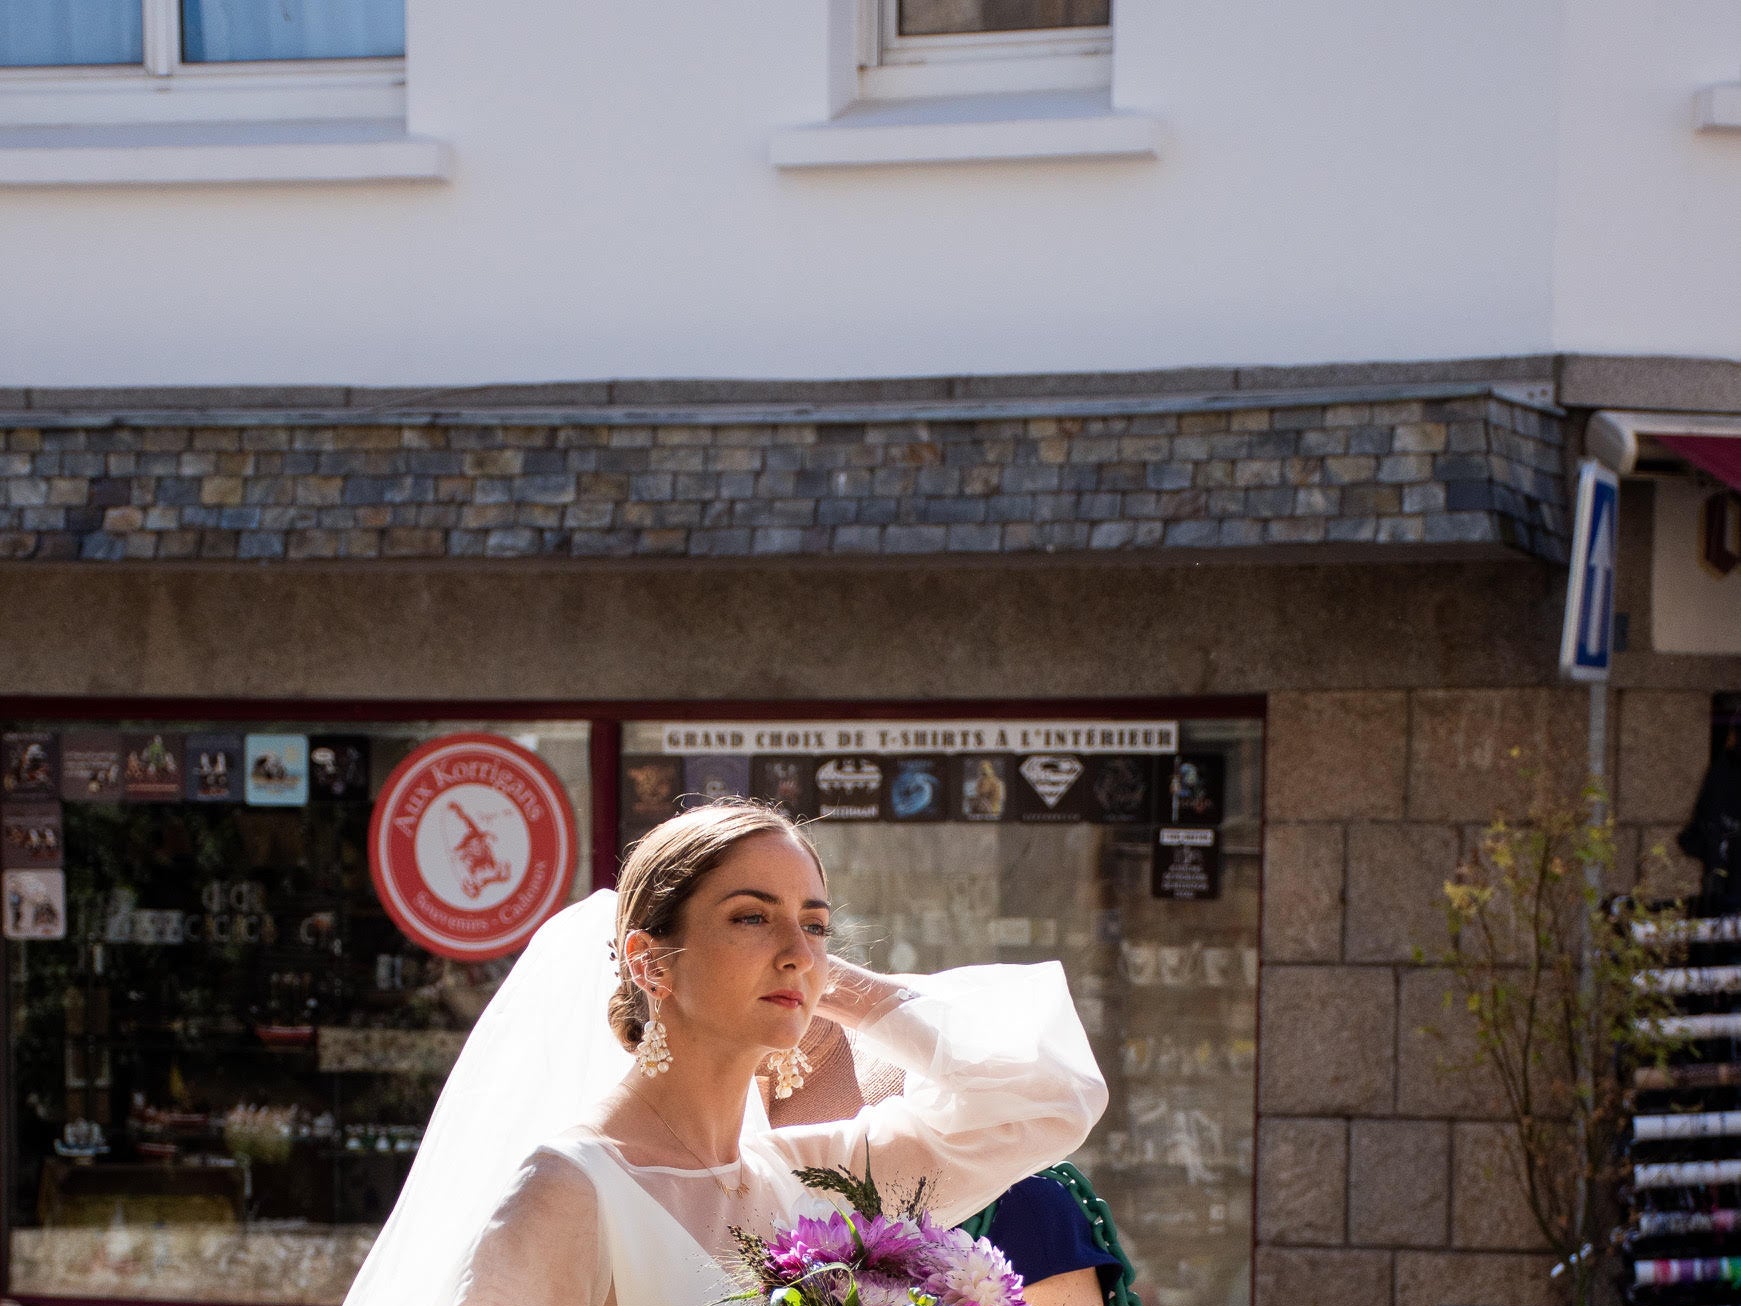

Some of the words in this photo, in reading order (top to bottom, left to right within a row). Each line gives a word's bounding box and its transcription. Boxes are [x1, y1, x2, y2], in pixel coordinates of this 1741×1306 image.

[667, 729, 744, 748] GRAND
[755, 729, 825, 748] CHOIX
[837, 729, 865, 748] DE
[879, 729, 985, 747] T-SHIRTS
[394, 781, 434, 838] Aux
[431, 758, 545, 822] Korrigans
